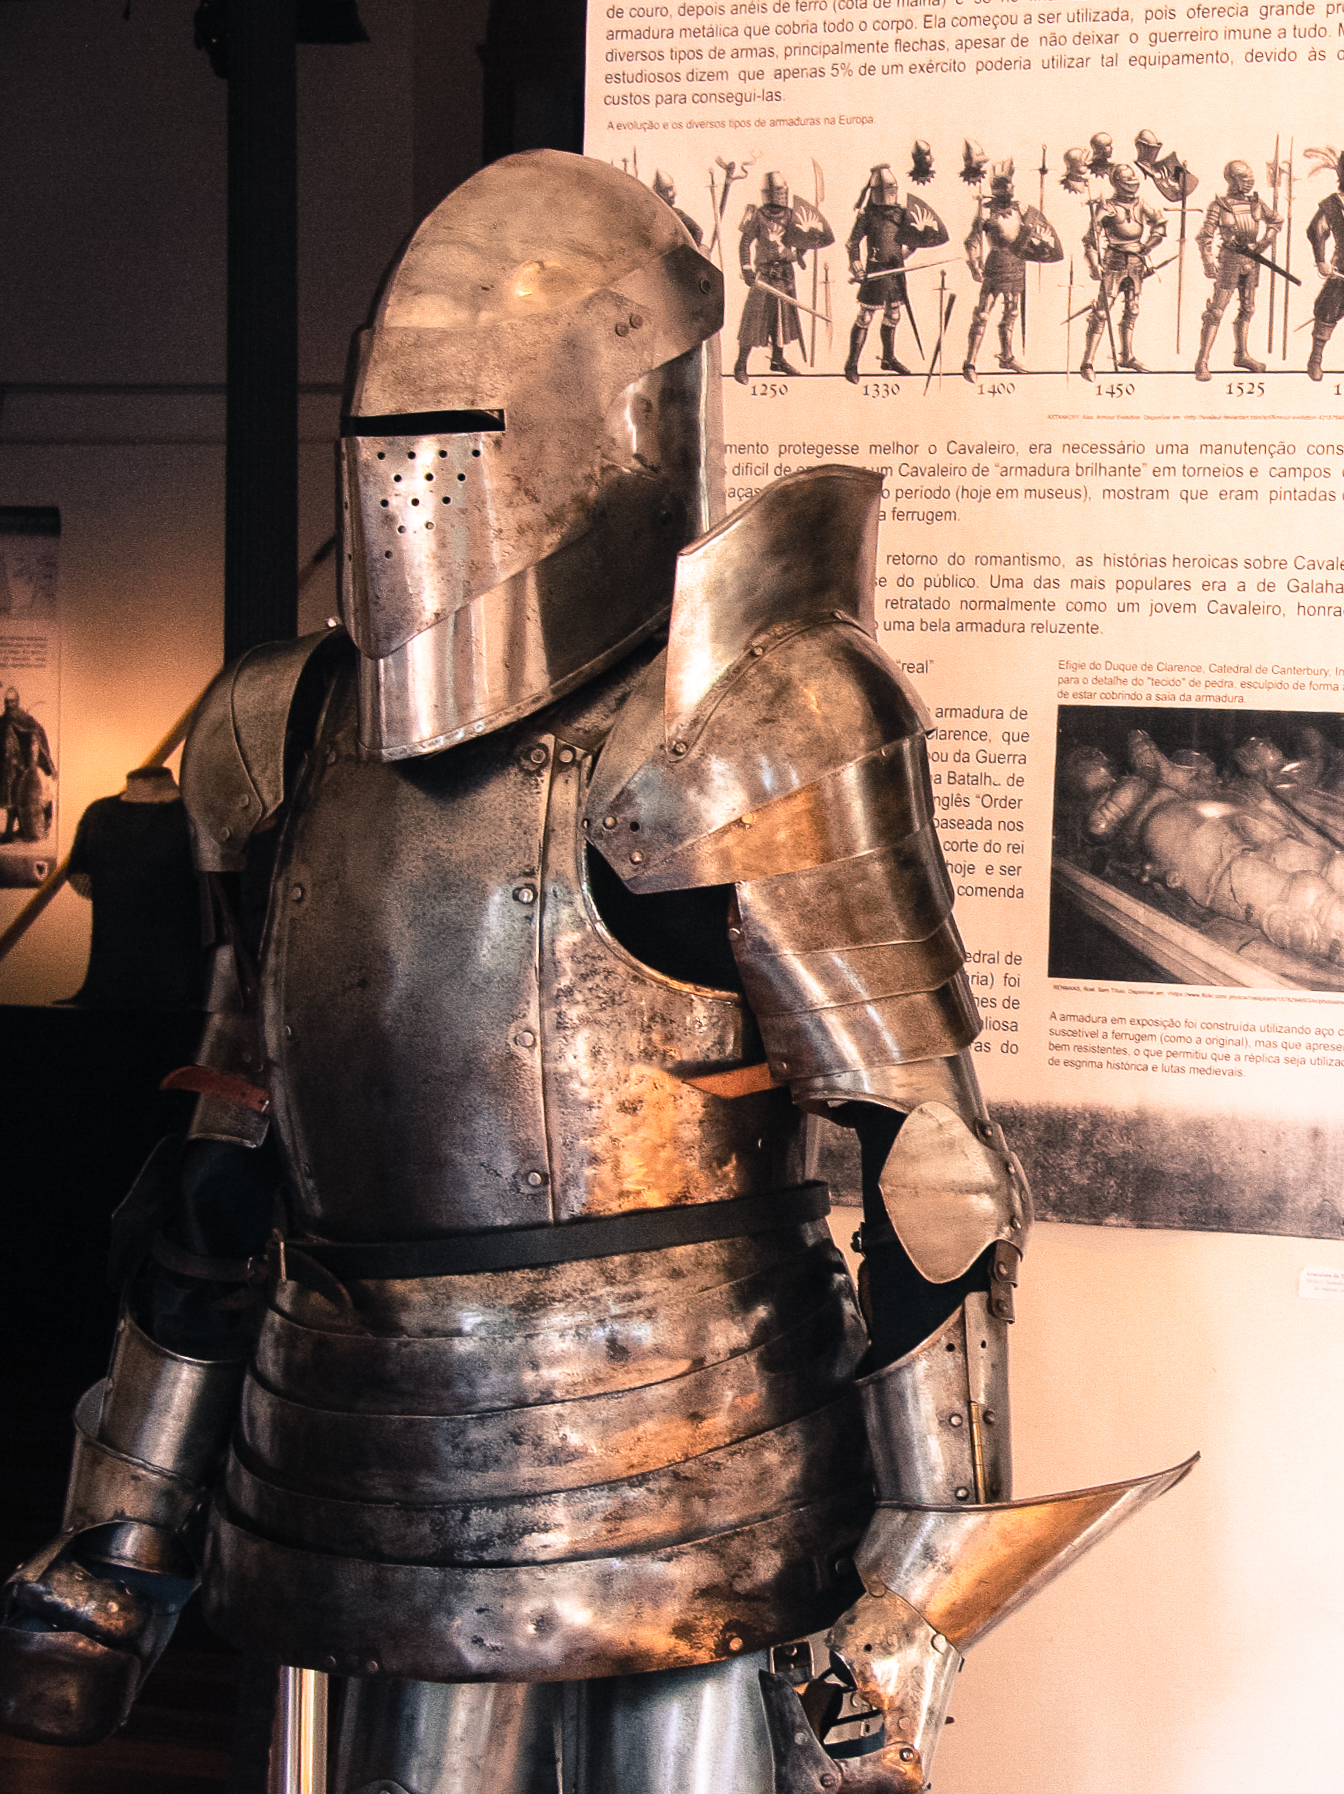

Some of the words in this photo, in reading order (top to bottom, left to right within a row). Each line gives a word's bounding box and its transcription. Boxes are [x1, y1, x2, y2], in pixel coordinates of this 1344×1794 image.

[628, 5, 673, 19] couro,
[677, 1, 726, 19] depois
[730, 0, 768, 16] anéis
[794, 0, 828, 13] ferro
[605, 25, 675, 41] armadura
[679, 23, 739, 39] metálica
[743, 24, 771, 38] que
[774, 19, 818, 36] cobria
[822, 17, 855, 34] todo
[872, 18, 918, 33] corpo.
[922, 13, 946, 30] Ela
[950, 14, 1019, 30] começou
[1066, 6, 1134, 24] utilizada,
[1144, 4, 1177, 24] pois
[1186, 2, 1249, 20] oferecia
[1258, 0, 1316, 20] grande
[605, 48, 665, 63] diversos
[669, 46, 704, 63] tipos
[730, 46, 779, 60] armas,
[784, 39, 890, 59] principalmente
[893, 37, 950, 53] flechas,
[954, 36, 1007, 53] apesar
[1039, 32, 1068, 47] não
[1072, 30, 1120, 46] deixar
[1148, 26, 1219, 47] guerreiro
[1223, 25, 1272, 41] imune
[1292, 22, 1332, 39] tudo.
[604, 68, 682, 84] estudiosos
[685, 67, 729, 83] dizem
[737, 69, 766, 82] que
[773, 66, 826, 81] apenas
[830, 62, 854, 78] 5%
[908, 58, 967, 75] exército
[975, 55, 1032, 75] poderia
[1041, 53, 1092, 70] utilizar
[1128, 49, 1234, 70] equipamento,
[1244, 46, 1298, 64] devido
[603, 91, 651, 106] custos
[654, 92, 687, 108] para
[691, 87, 786, 106] consegui-las.
[750, 383, 788, 399] 1250
[862, 383, 900, 399] 1330
[978, 382, 1016, 398] 1400
[1096, 383, 1136, 399] 1450
[1226, 382, 1265, 398] 1525
[778, 441, 860, 459] protegesse
[868, 440, 920, 456] melhor
[946, 440, 1019, 457] Cavaleiro,
[1062, 440, 1146, 455] necessário
[1155, 443, 1189, 455] uma
[1199, 440, 1296, 459] manutenção
[898, 462, 968, 478] Cavaleiro
[1181, 463, 1244, 478] torneios
[1268, 466, 1332, 482] campos
[894, 484, 951, 503] período
[1024, 484, 1092, 503] museus),
[1102, 486, 1170, 501] mostram
[1218, 488, 1259, 501] eram
[1268, 486, 1337, 505] pintadas
[890, 506, 960, 526] ferrugem.
[886, 551, 939, 566] retorno
[974, 552, 1066, 569] romantismo,
[1102, 552, 1168, 569] histórias
[1172, 553, 1239, 570] heroicas
[1243, 554, 1288, 570] sobre
[989, 573, 1024, 589] Uma
[1070, 575, 1106, 591] mais
[1115, 576, 1192, 594] populares
[1201, 580, 1227, 592] era
[884, 595, 951, 612] retratado
[959, 596, 1056, 612] normalmente
[1065, 600, 1108, 613] como
[1148, 598, 1197, 618] jovem
[1206, 599, 1286, 618] Cavaleiro,
[883, 620, 915, 632] uma
[919, 617, 951, 633] bela
[955, 618, 1026, 634] armadura
[1030, 619, 1104, 635] reluzente.
[1104, 660, 1138, 674] Duque
[1208, 662, 1253, 674] Catedral
[1057, 676, 1080, 687] para
[1090, 675, 1129, 686] detalhe
[1239, 679, 1290, 692] esculpido
[1308, 680, 1340, 692] forma
[1072, 690, 1098, 700] estar
[1099, 691, 1143, 701] cobrindo
[934, 705, 1004, 720] armadura
[1001, 730, 1030, 746] que
[975, 748, 1027, 765] Guerra
[942, 838, 979, 853] corte
[956, 884, 1024, 900] comenda
[1058, 1012, 1108, 1025] armadura
[1128, 1017, 1182, 1030] exposição
[1259, 1023, 1312, 1035] utilizando
[1314, 1027, 1335, 1039] aço
[1111, 1028, 1157, 1044] ferrugem
[1165, 1049, 1208, 1060] permitiu
[1062, 1057, 1104, 1071] esgrima
[1161, 1062, 1186, 1074] lutas
